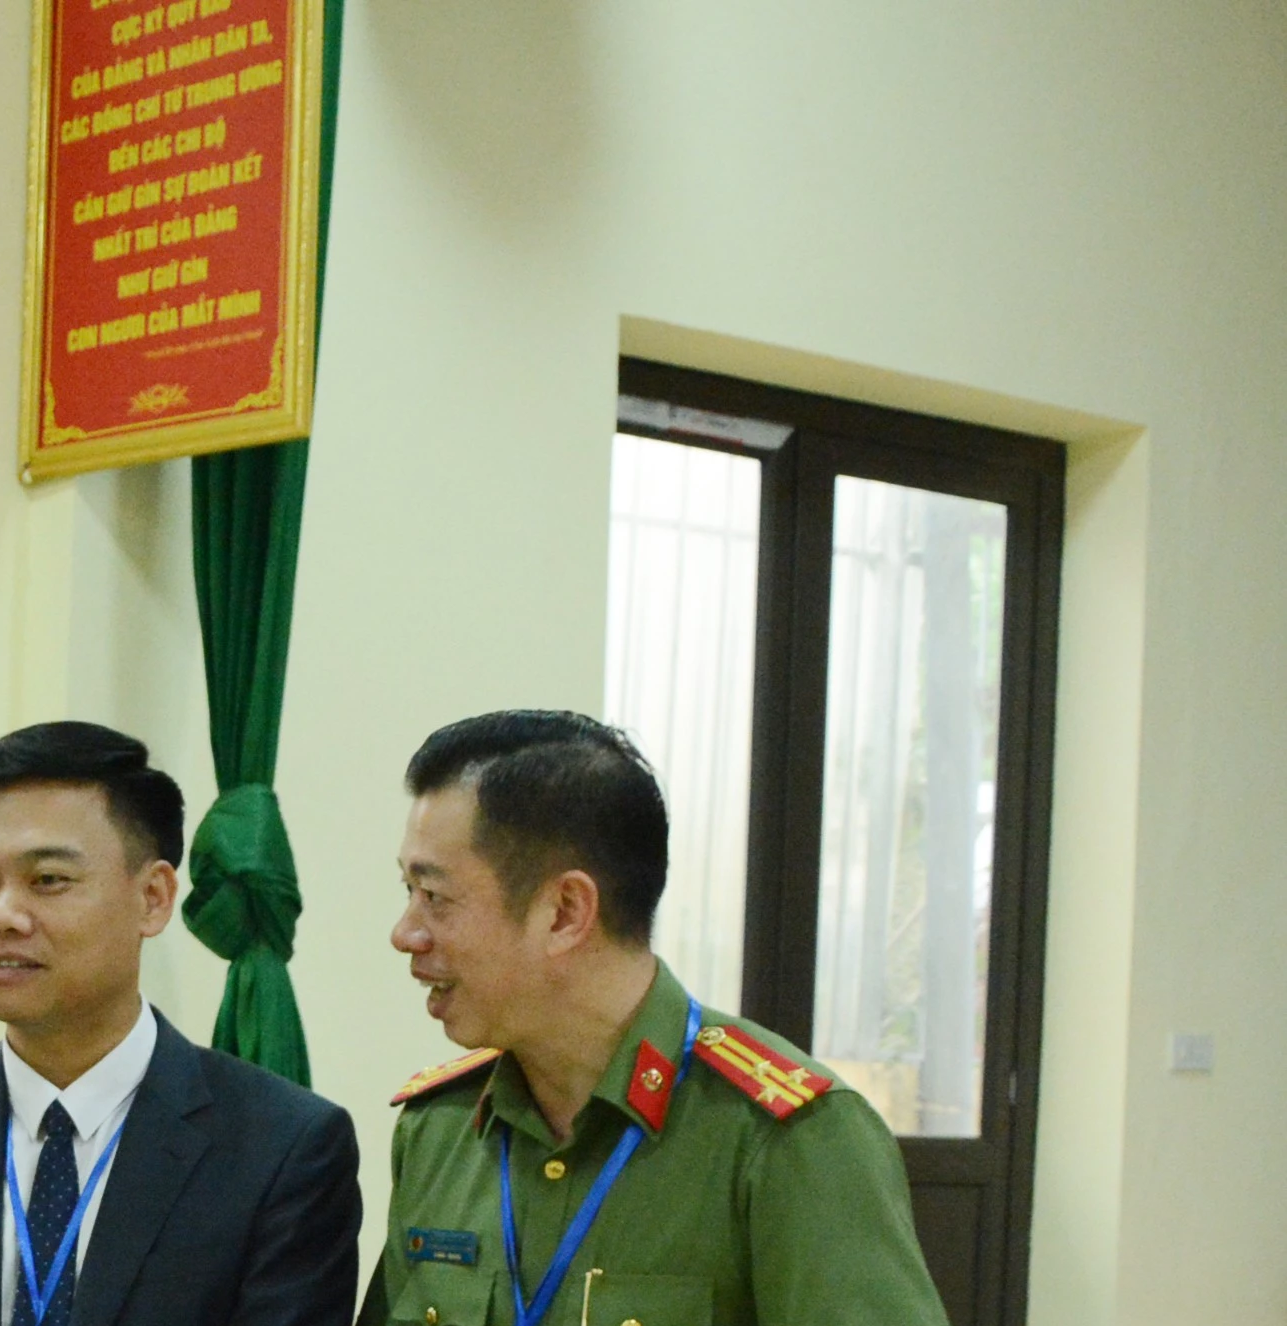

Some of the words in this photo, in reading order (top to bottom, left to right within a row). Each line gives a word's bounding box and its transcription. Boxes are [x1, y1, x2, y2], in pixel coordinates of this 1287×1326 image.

[72, 67, 101, 99] CỦA
[102, 56, 144, 90] ĐẢNG
[145, 46, 167, 77] VÀ
[168, 35, 213, 71] NHÂN
[213, 24, 248, 57] DÂN
[109, 140, 140, 173] ĐẾN
[141, 132, 173, 164] CÁC
[174, 126, 203, 156] CHI
[202, 114, 227, 149] BỘ
[93, 226, 133, 261] NHẤT
[134, 220, 159, 252] TRÍ
[160, 211, 193, 246] CỦA
[193, 203, 238, 239] ĐẢNG
[117, 267, 152, 299] NHƯ
[151, 258, 180, 292] GIỮ
[180, 255, 209, 286] GÌN
[67, 325, 99, 353] CON
[147, 301, 180, 336] CỦA
[216, 289, 262, 321] MÌNH
